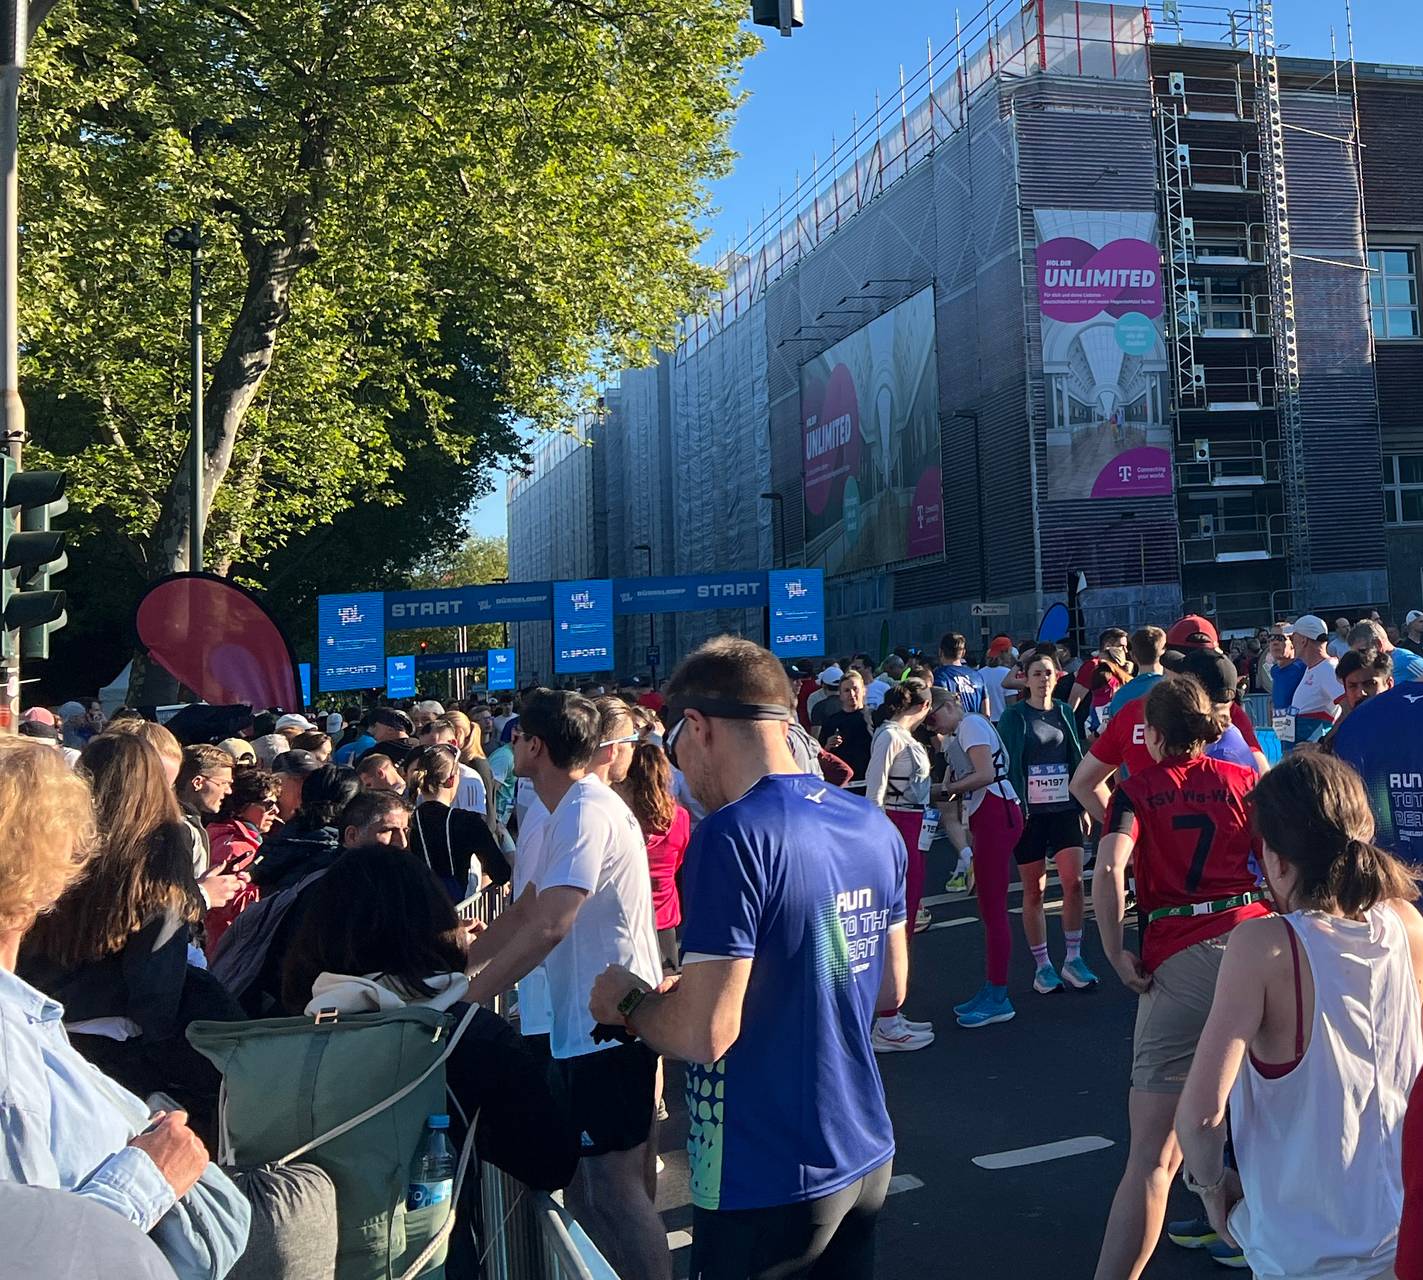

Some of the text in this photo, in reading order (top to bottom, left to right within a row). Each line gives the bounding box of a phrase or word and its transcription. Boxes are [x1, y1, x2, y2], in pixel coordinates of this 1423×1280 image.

[1044, 269, 1156, 287] UNLIMITED
[806, 414, 851, 460] UNLIMITED
[1118, 466, 1131, 482] T
[571, 591, 589, 602] uni
[697, 583, 760, 598] START
[392, 600, 463, 617] START
[561, 648, 607, 659] D.SPORTS
[1389, 773, 1422, 788] RUN
[1172, 814, 1216, 894] 7
[847, 935, 879, 962] EAT
